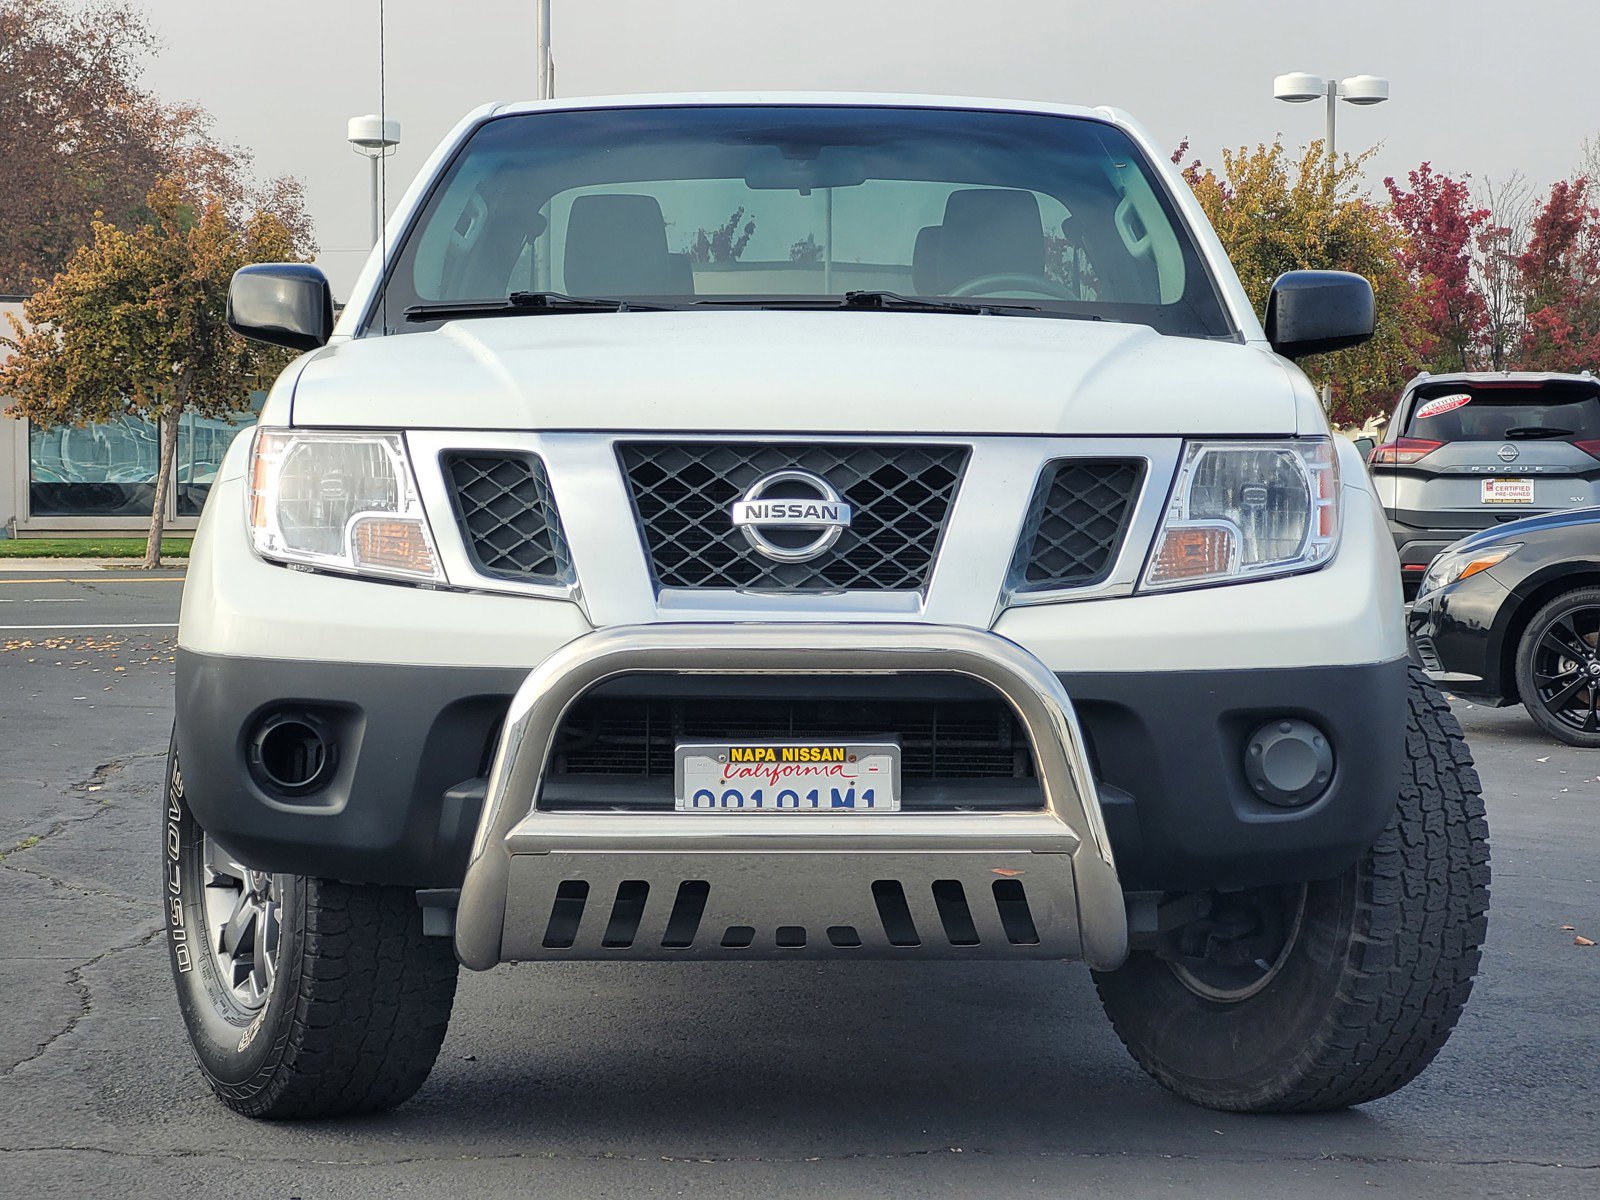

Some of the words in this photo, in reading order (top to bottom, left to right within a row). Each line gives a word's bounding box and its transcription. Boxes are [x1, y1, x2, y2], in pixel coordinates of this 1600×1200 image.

[745, 504, 838, 520] NISSAN
[731, 748, 776, 762] NAPA
[782, 748, 845, 762] NISSAN
[723, 763, 858, 787] California
[168, 750, 192, 973] DISCOVE
